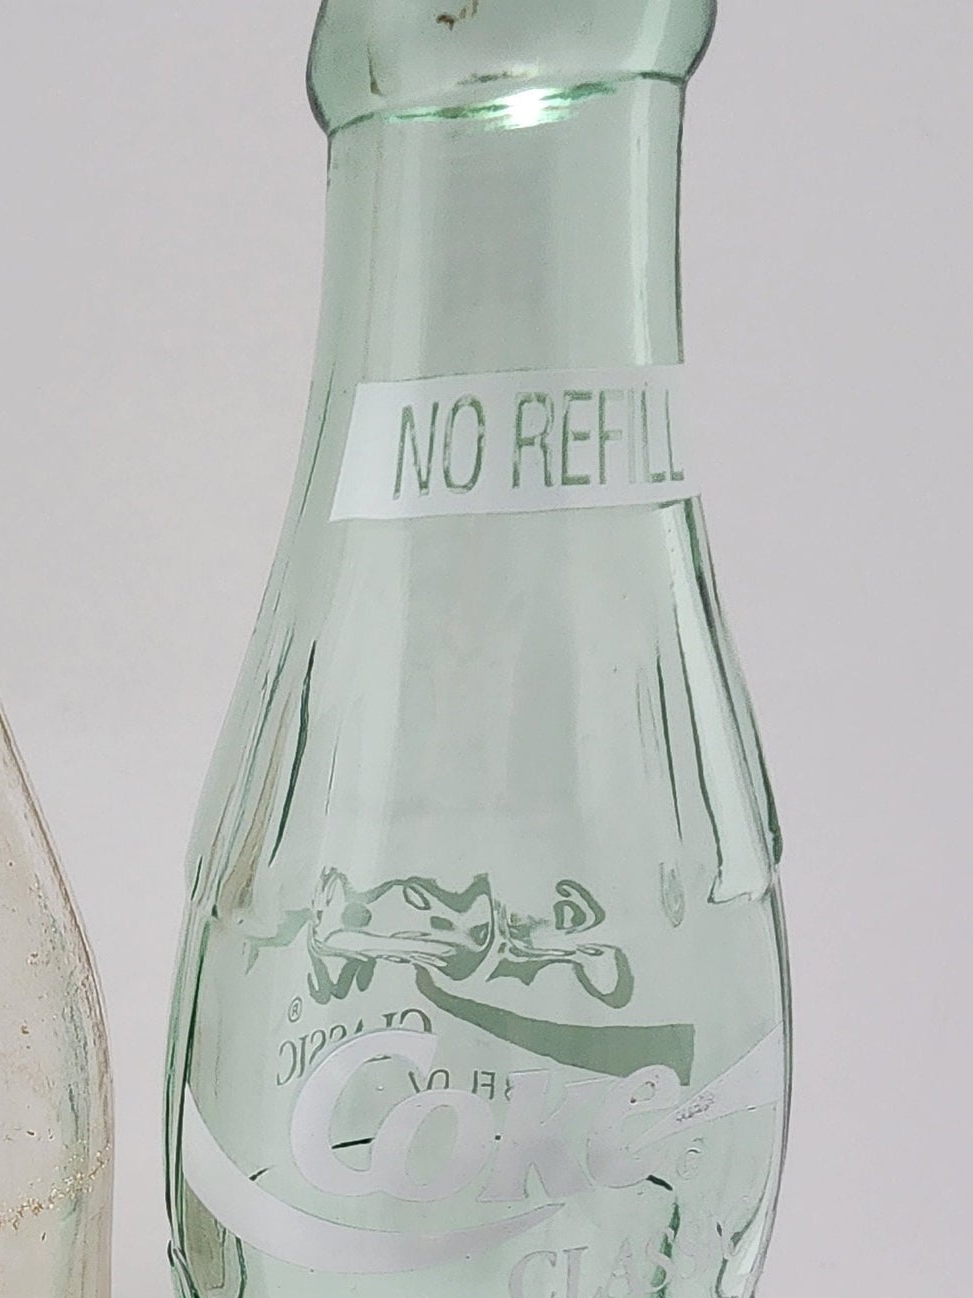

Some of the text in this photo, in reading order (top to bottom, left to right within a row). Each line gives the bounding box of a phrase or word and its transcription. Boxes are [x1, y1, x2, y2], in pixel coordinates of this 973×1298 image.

[392, 389, 685, 500] NO REFILL
[290, 1027, 683, 1204] Coke
